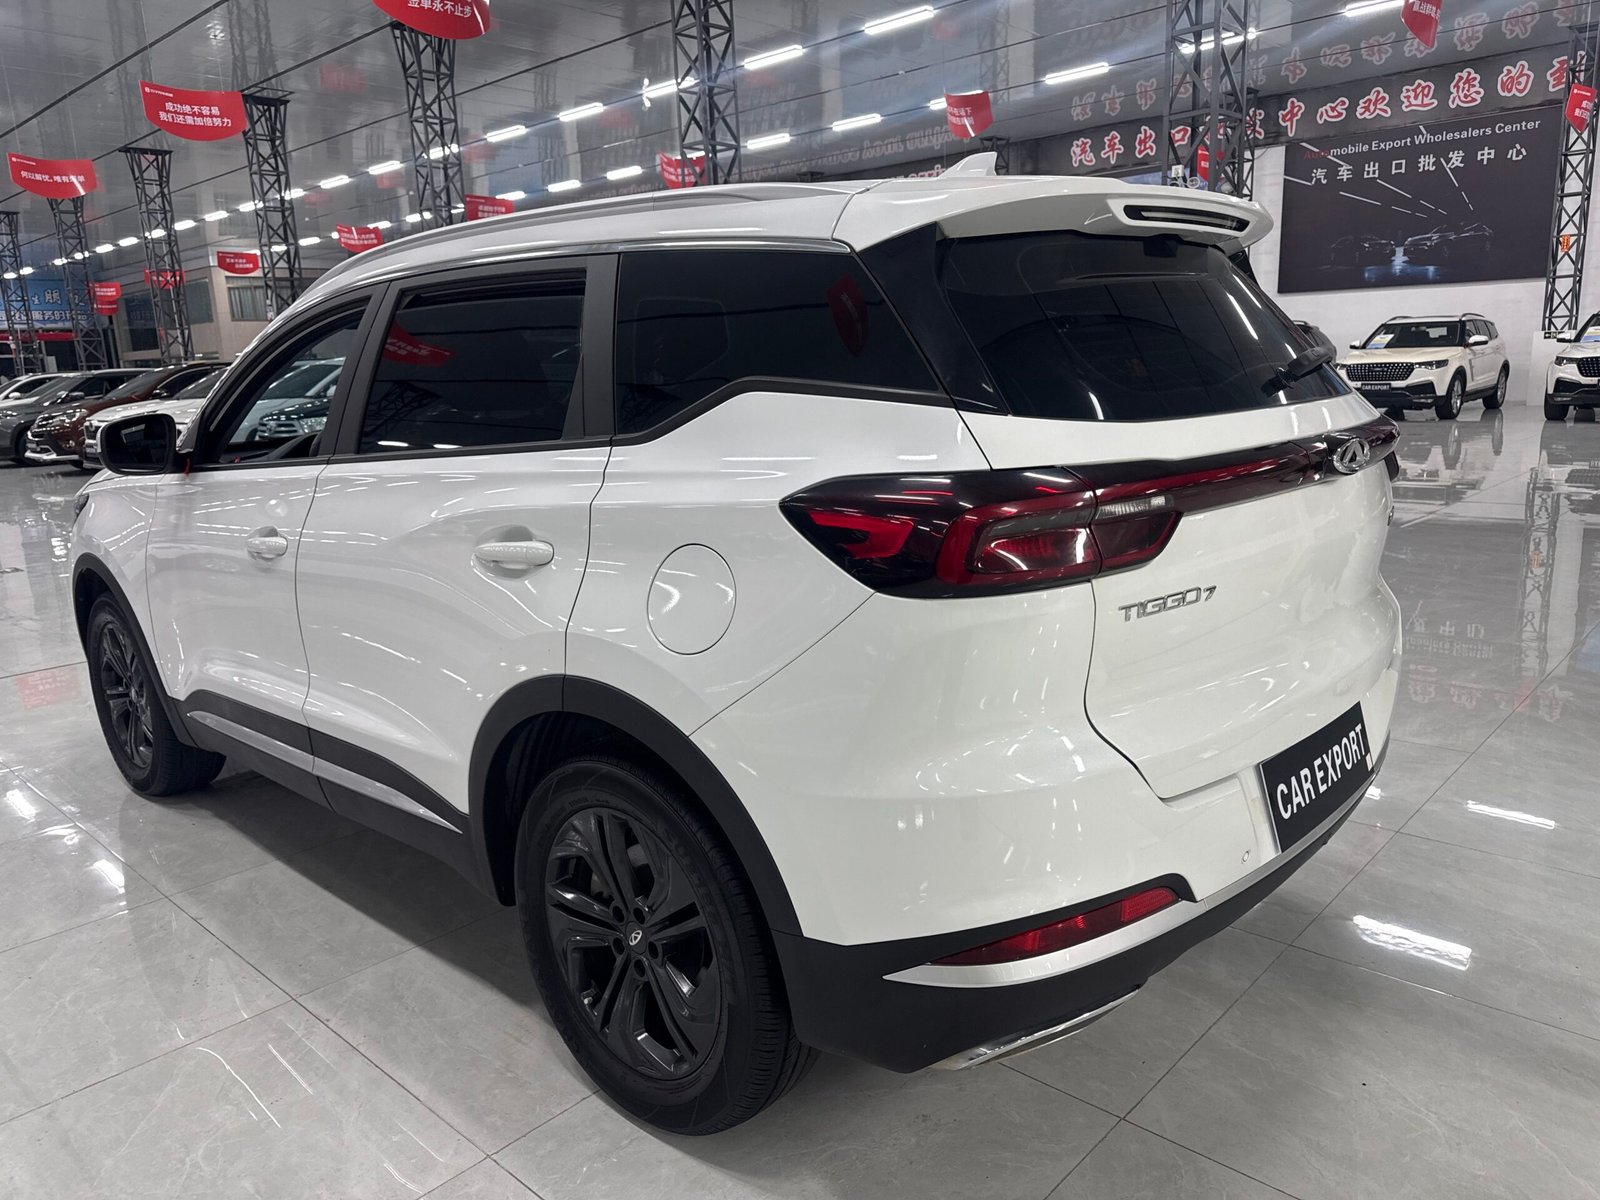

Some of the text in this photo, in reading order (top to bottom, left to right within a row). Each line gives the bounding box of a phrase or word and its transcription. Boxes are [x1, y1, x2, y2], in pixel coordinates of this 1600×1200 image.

[158, 111, 232, 127] 我们还需加倍努力
[165, 102, 220, 116] 成功绝不容易
[1371, 137, 1412, 153] Export
[1413, 127, 1492, 145] Wholesalers
[1495, 119, 1541, 134] Center
[1311, 143, 1528, 185] 汽车出口批发中心
[1118, 585, 1217, 622] TIGGO 7
[1276, 723, 1366, 820] CAR EXPORT
